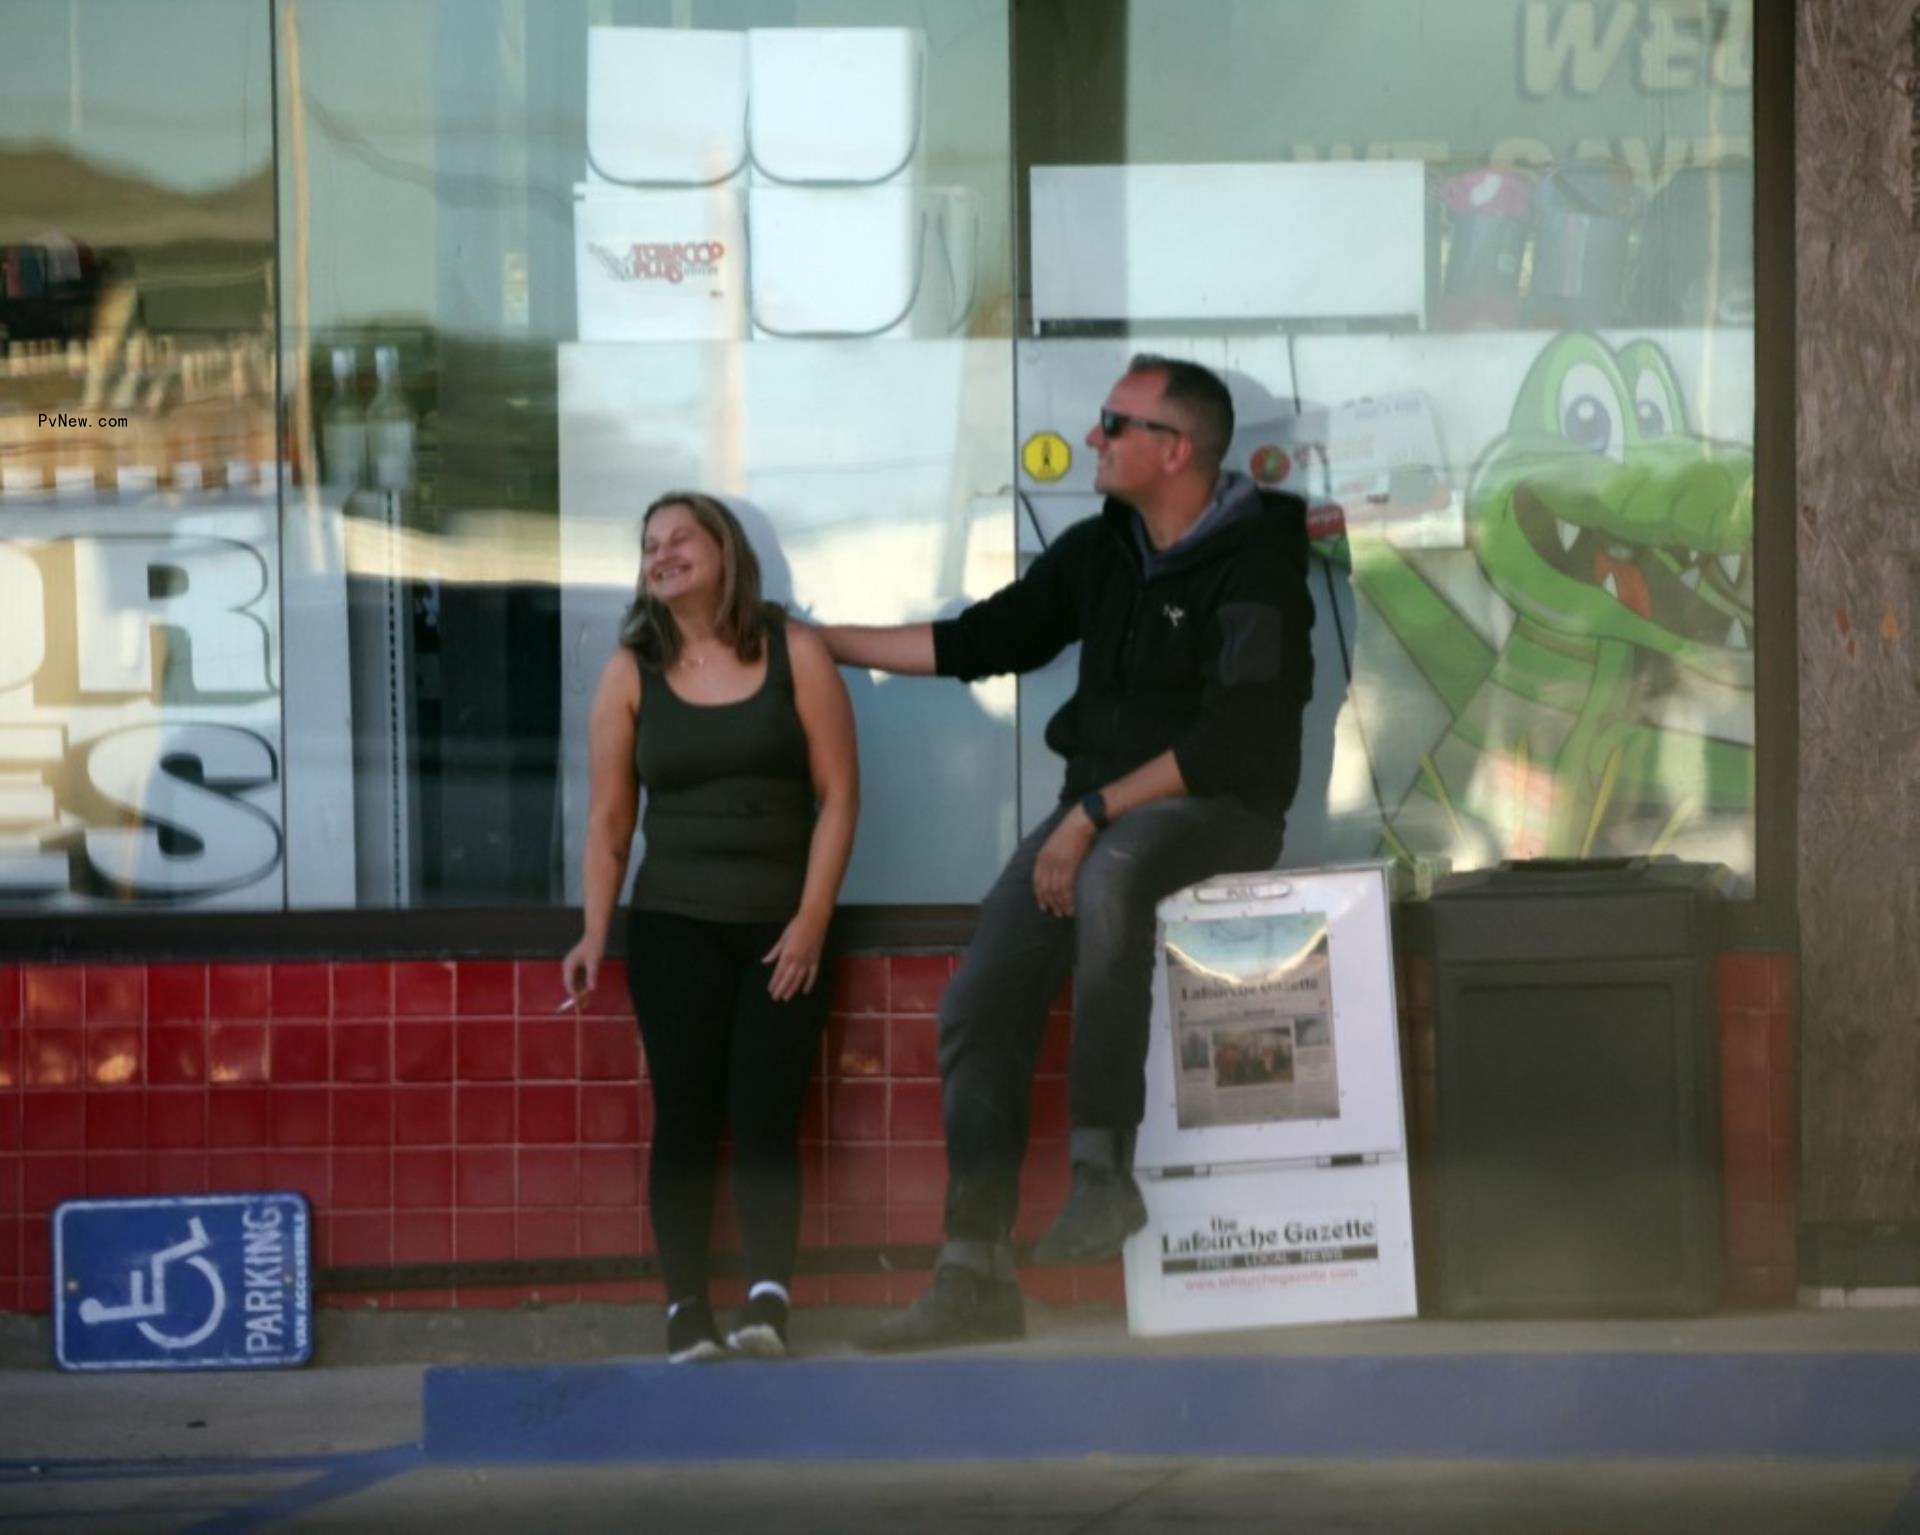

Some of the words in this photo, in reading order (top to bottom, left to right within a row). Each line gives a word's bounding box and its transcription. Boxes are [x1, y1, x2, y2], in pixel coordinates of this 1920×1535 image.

[1161, 1224, 1278, 1253] Lafourche
[1284, 1218, 1375, 1244] Gazette
[1210, 1215, 1238, 1233] the
[1300, 1245, 1344, 1264] NEWS
[242, 1205, 284, 1355] PARKING
